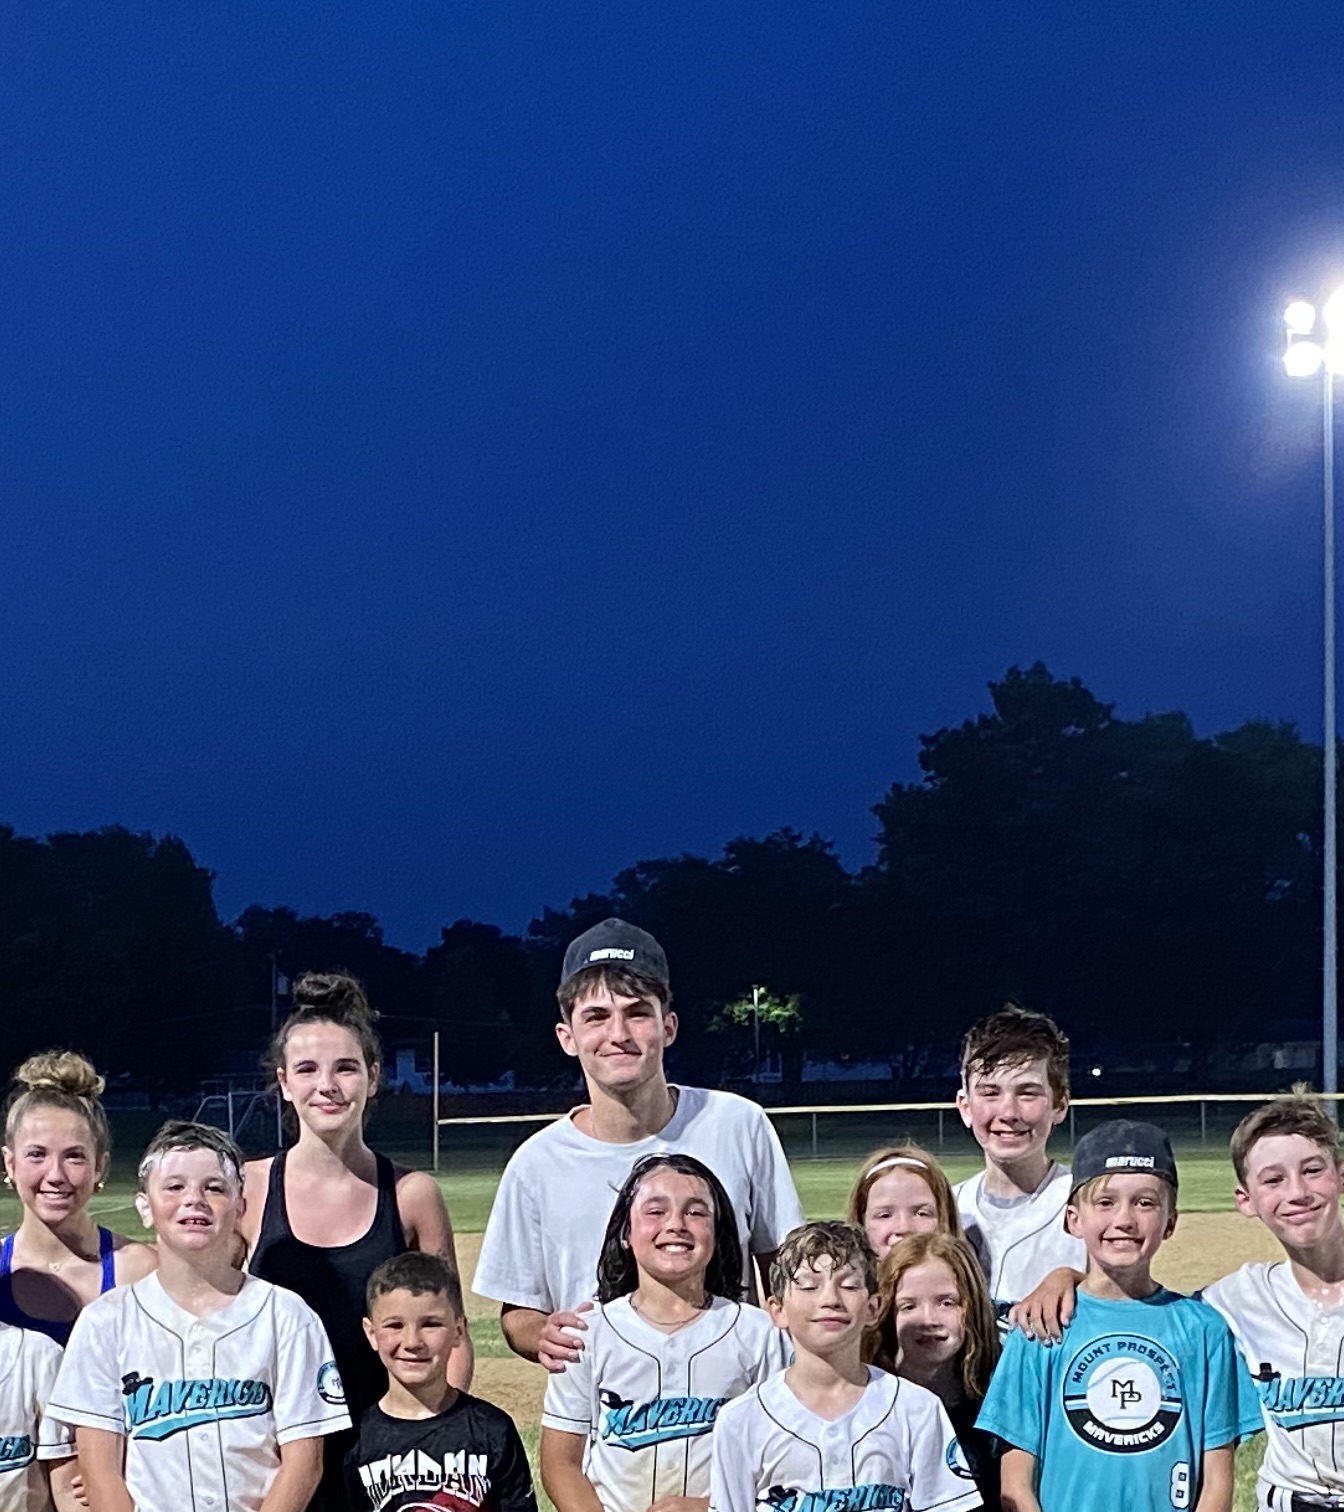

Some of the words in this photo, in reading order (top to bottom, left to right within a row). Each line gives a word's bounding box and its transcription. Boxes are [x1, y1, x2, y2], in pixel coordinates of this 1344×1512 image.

[1071, 1343, 1112, 1384] MOUNT
[1111, 1379, 1143, 1410] MP
[1081, 1420, 1166, 1446] MAVERICKS
[1169, 1460, 1191, 1510] 8
